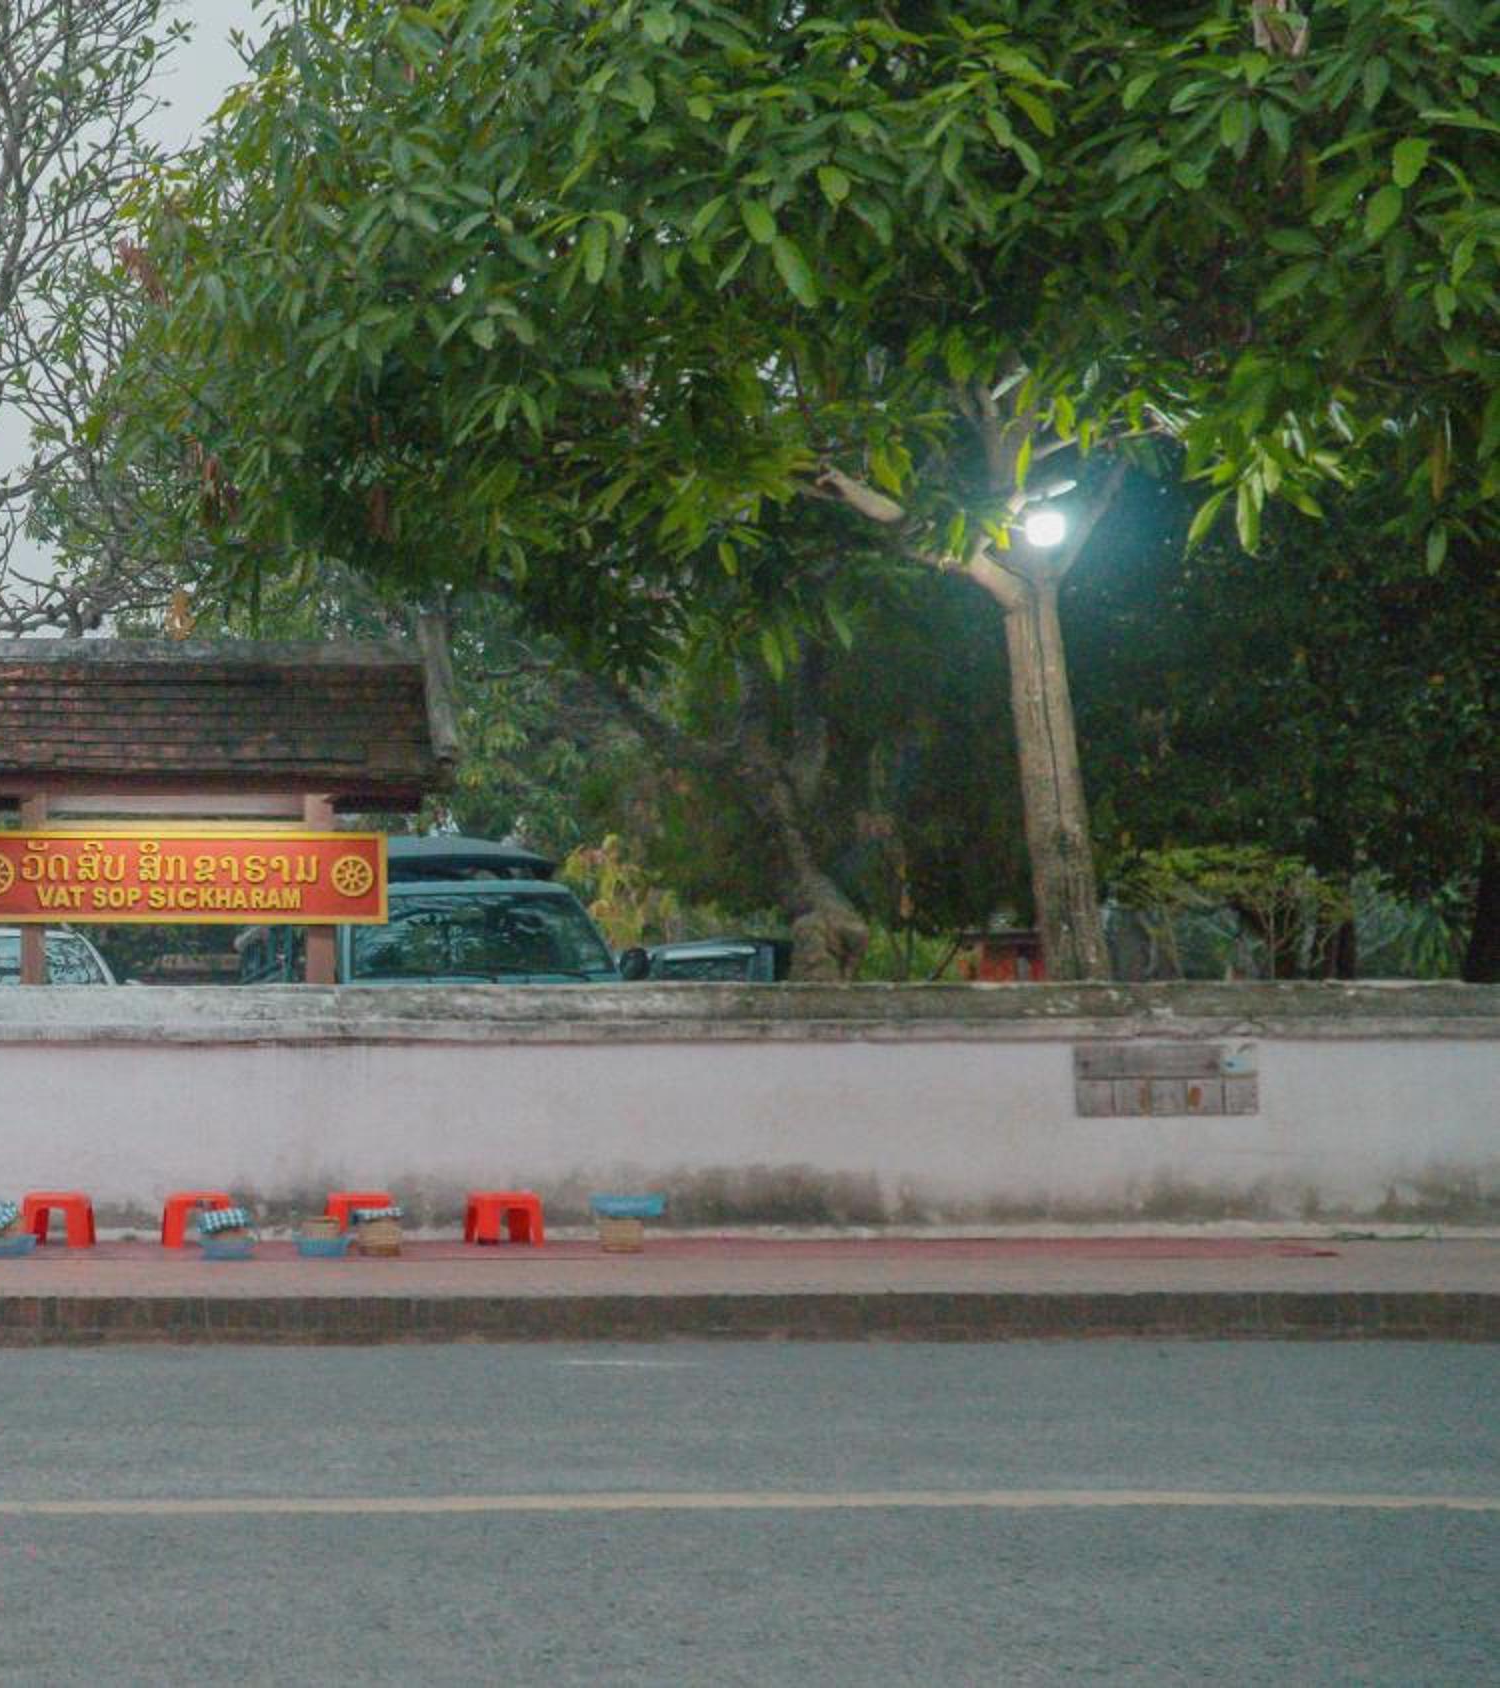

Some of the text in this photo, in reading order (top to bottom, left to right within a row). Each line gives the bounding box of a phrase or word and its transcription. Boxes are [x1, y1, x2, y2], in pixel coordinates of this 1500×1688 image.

[37, 884, 302, 909] VAT SOP SICKHARAM
